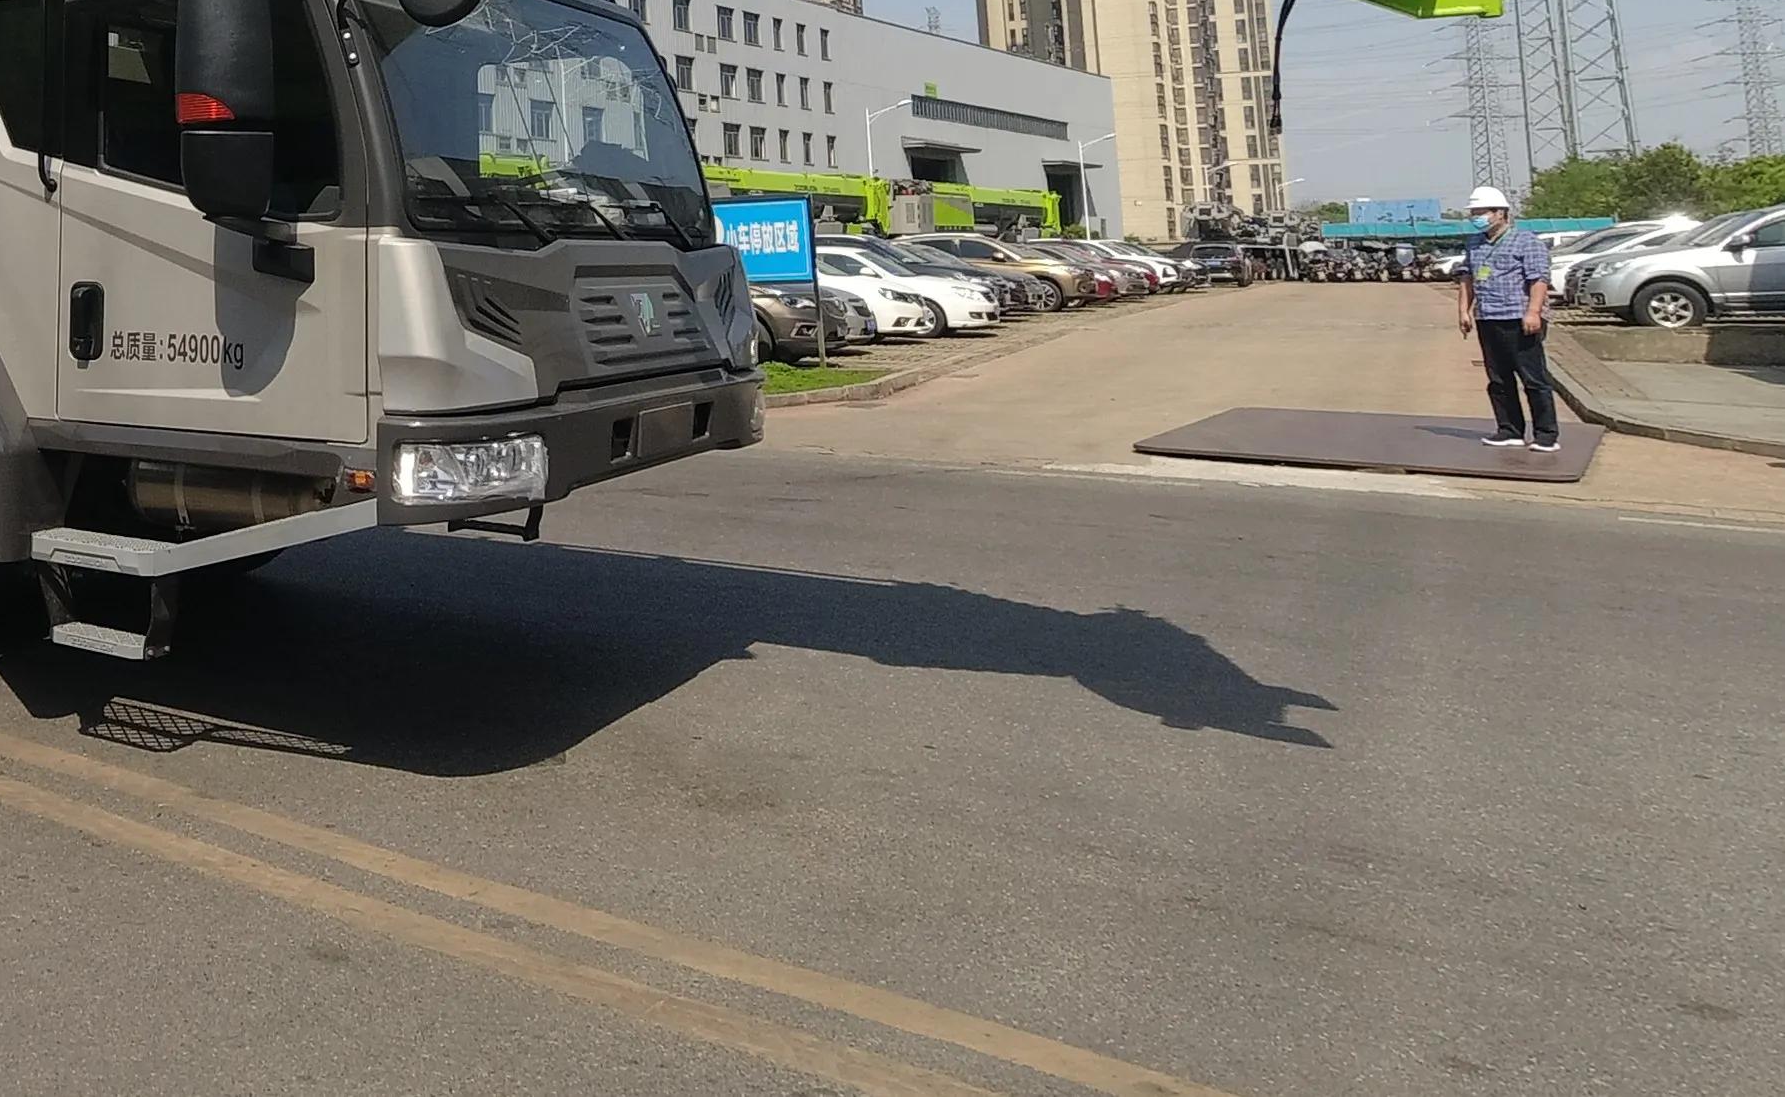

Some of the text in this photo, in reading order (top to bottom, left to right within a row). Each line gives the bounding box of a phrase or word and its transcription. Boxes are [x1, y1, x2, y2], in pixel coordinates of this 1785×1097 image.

[726, 220, 800, 255] 小车停放区域
